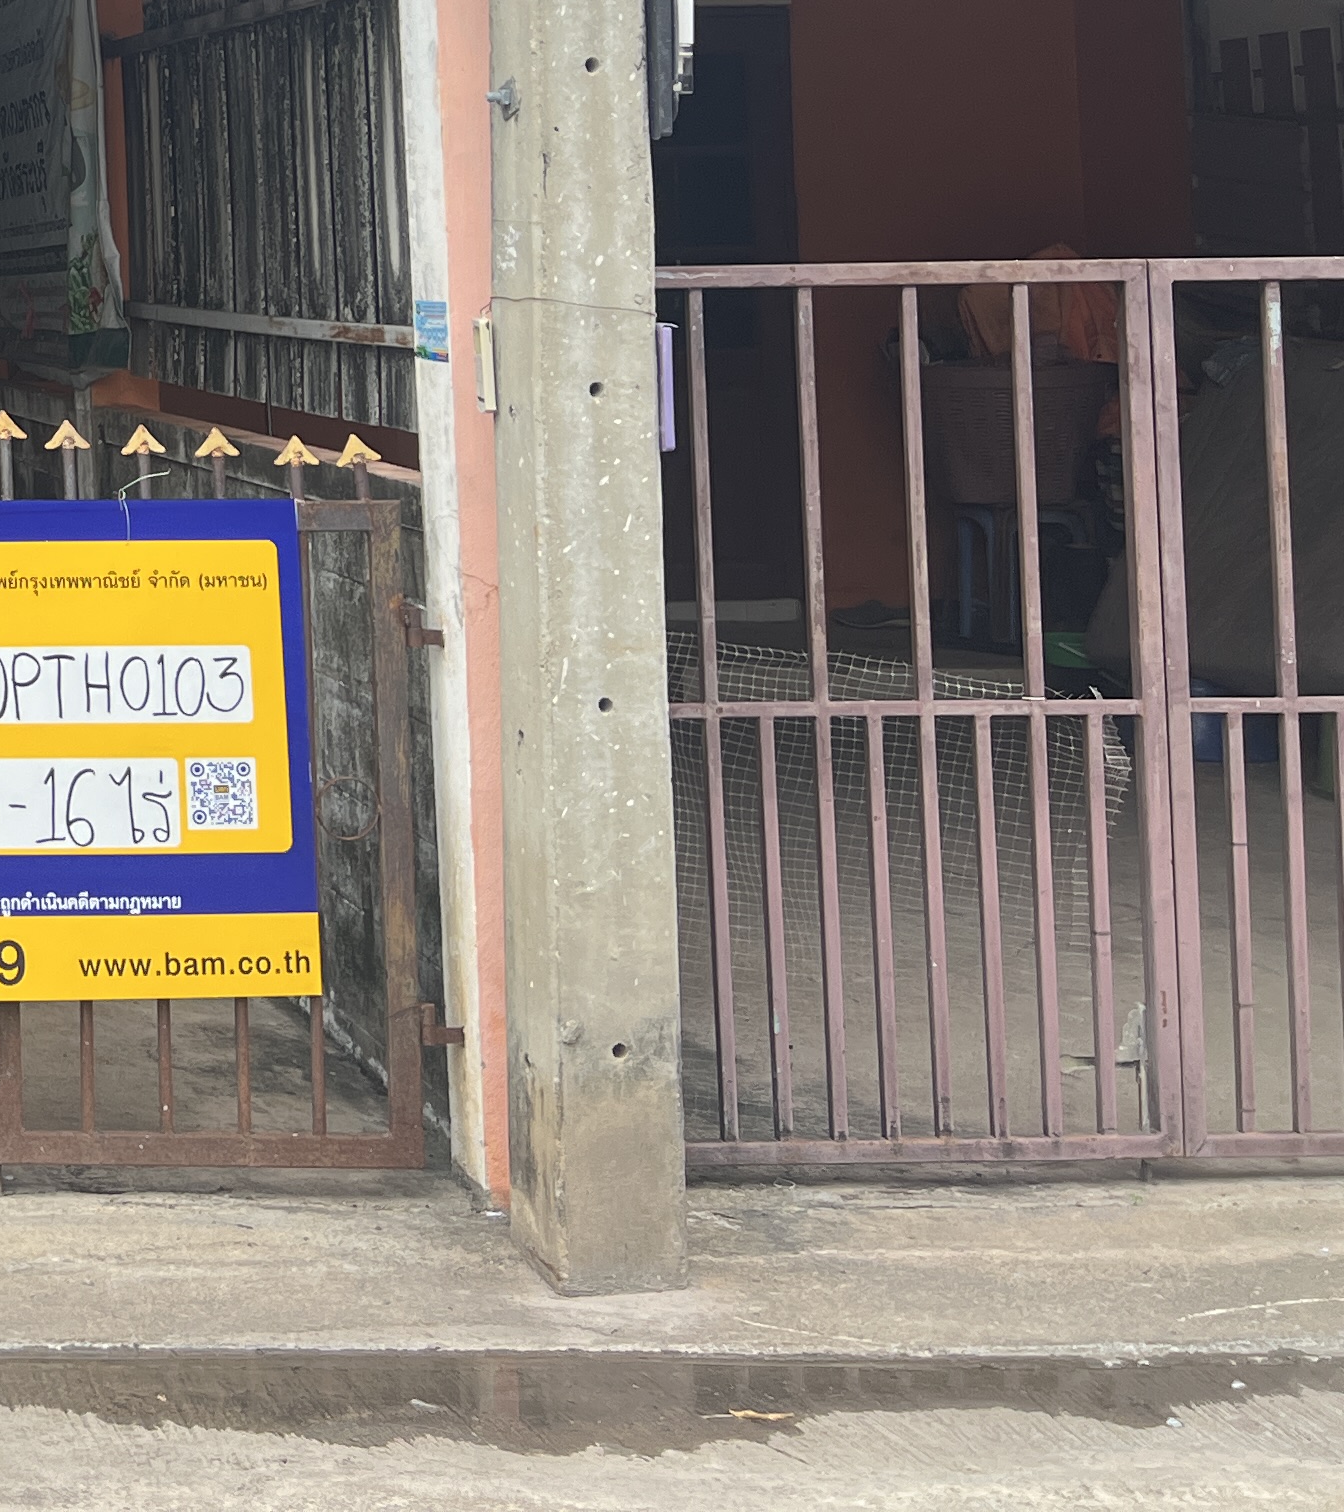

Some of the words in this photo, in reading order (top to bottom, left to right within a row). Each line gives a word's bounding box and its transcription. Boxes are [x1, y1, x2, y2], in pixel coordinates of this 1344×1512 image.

[148, 570, 190, 589] จำกัด
[199, 573, 267, 591] (มหาชน)
[79, 950, 311, 977] www.bam.co.th
